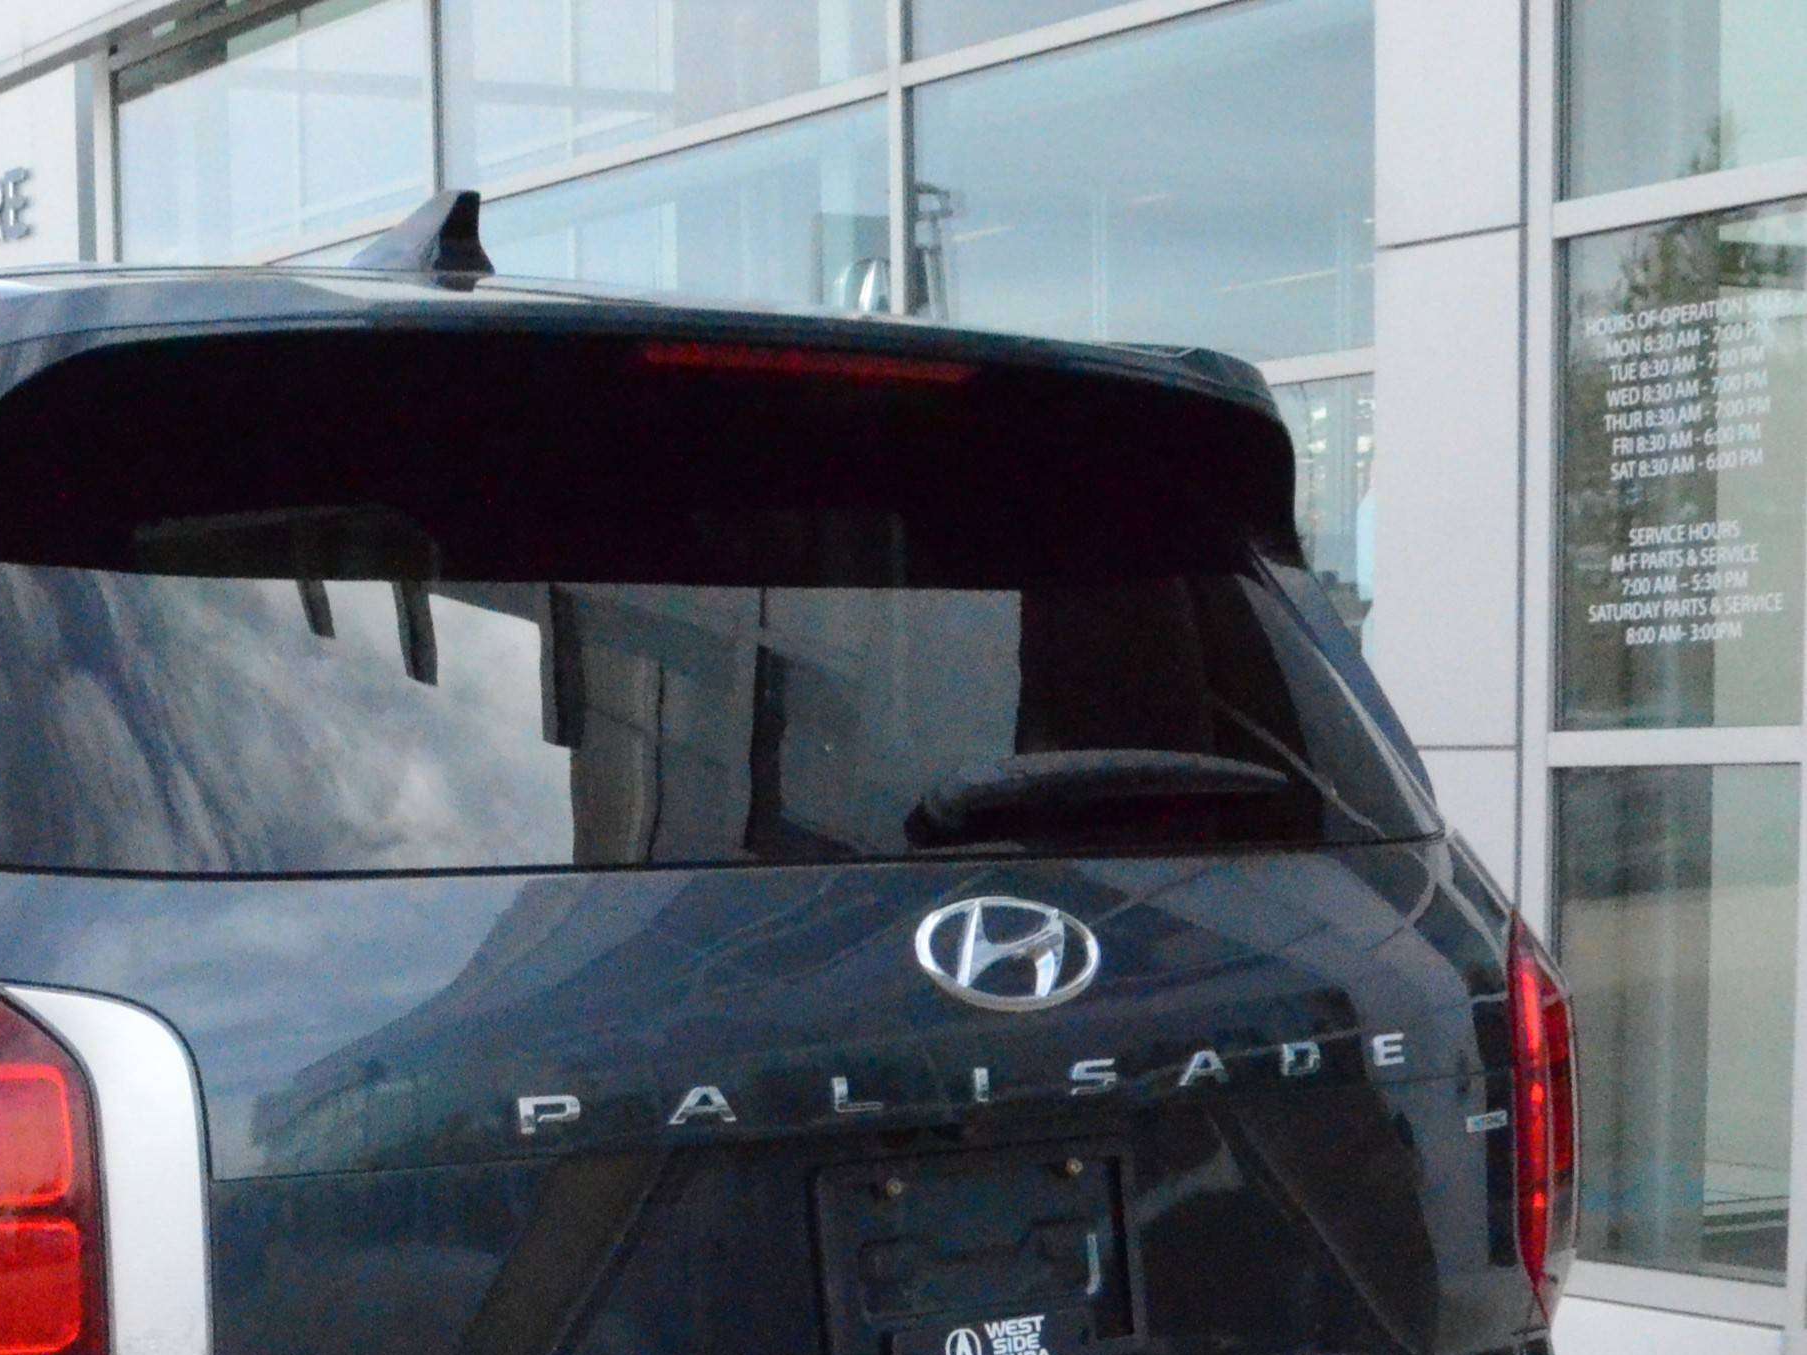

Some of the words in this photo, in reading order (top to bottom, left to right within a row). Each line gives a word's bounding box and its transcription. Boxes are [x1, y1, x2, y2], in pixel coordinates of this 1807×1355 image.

[1585, 313, 1634, 337] HOURS
[1637, 309, 1657, 330] OF
[1660, 297, 1743, 326] OPERATION
[1605, 338, 1641, 358] MON
[1643, 332, 1673, 353] 8:30
[1676, 328, 1700, 348] AM
[1745, 320, 1769, 339] PM
[1610, 361, 1637, 381] TUE
[1639, 358, 1668, 379] 8:30
[1672, 354, 1696, 375] AM
[1741, 345, 1765, 365] PM
[1606, 386, 1639, 407] WED
[1642, 383, 1672, 403] 8:30
[1675, 379, 1699, 398] AM
[1744, 369, 1769, 390] PM
[1603, 410, 1643, 432] THUR
[1645, 407, 1675, 428] 8:30
[1678, 404, 1702, 424] AM
[1746, 396, 1770, 416] PM
[1612, 436, 1634, 456] FRI
[1636, 433, 1665, 453] 8:30
[1668, 430, 1693, 449] AM
[1738, 422, 1761, 441] PM
[1610, 461, 1636, 481] SAT
[1638, 457, 1668, 478] 8:30
[1671, 454, 1695, 473] AM
[1741, 448, 1763, 466] PM
[1629, 524, 1686, 547] SERVICE
[1688, 520, 1740, 542] HOURS
[1610, 553, 1639, 573] M-F
[1641, 548, 1684, 570] PARTS
[1686, 548, 1698, 567] &
[1699, 543, 1760, 565] SERVICE
[1622, 576, 1651, 596] 7:00
[1653, 574, 1677, 593] AM
[1691, 572, 1722, 591] 5:30
[1724, 570, 1749, 588] PM
[1588, 601, 1661, 623] SATURDAY
[1664, 597, 1707, 617] PARTS
[1710, 597, 1722, 615] &
[1723, 592, 1784, 615] SERVICE
[1626, 626, 1655, 645] 8:00
[517, 1032, 1406, 1136] PALISADE
[984, 1314, 1045, 1339] WEST
[992, 1333, 1041, 1355] SIDE
